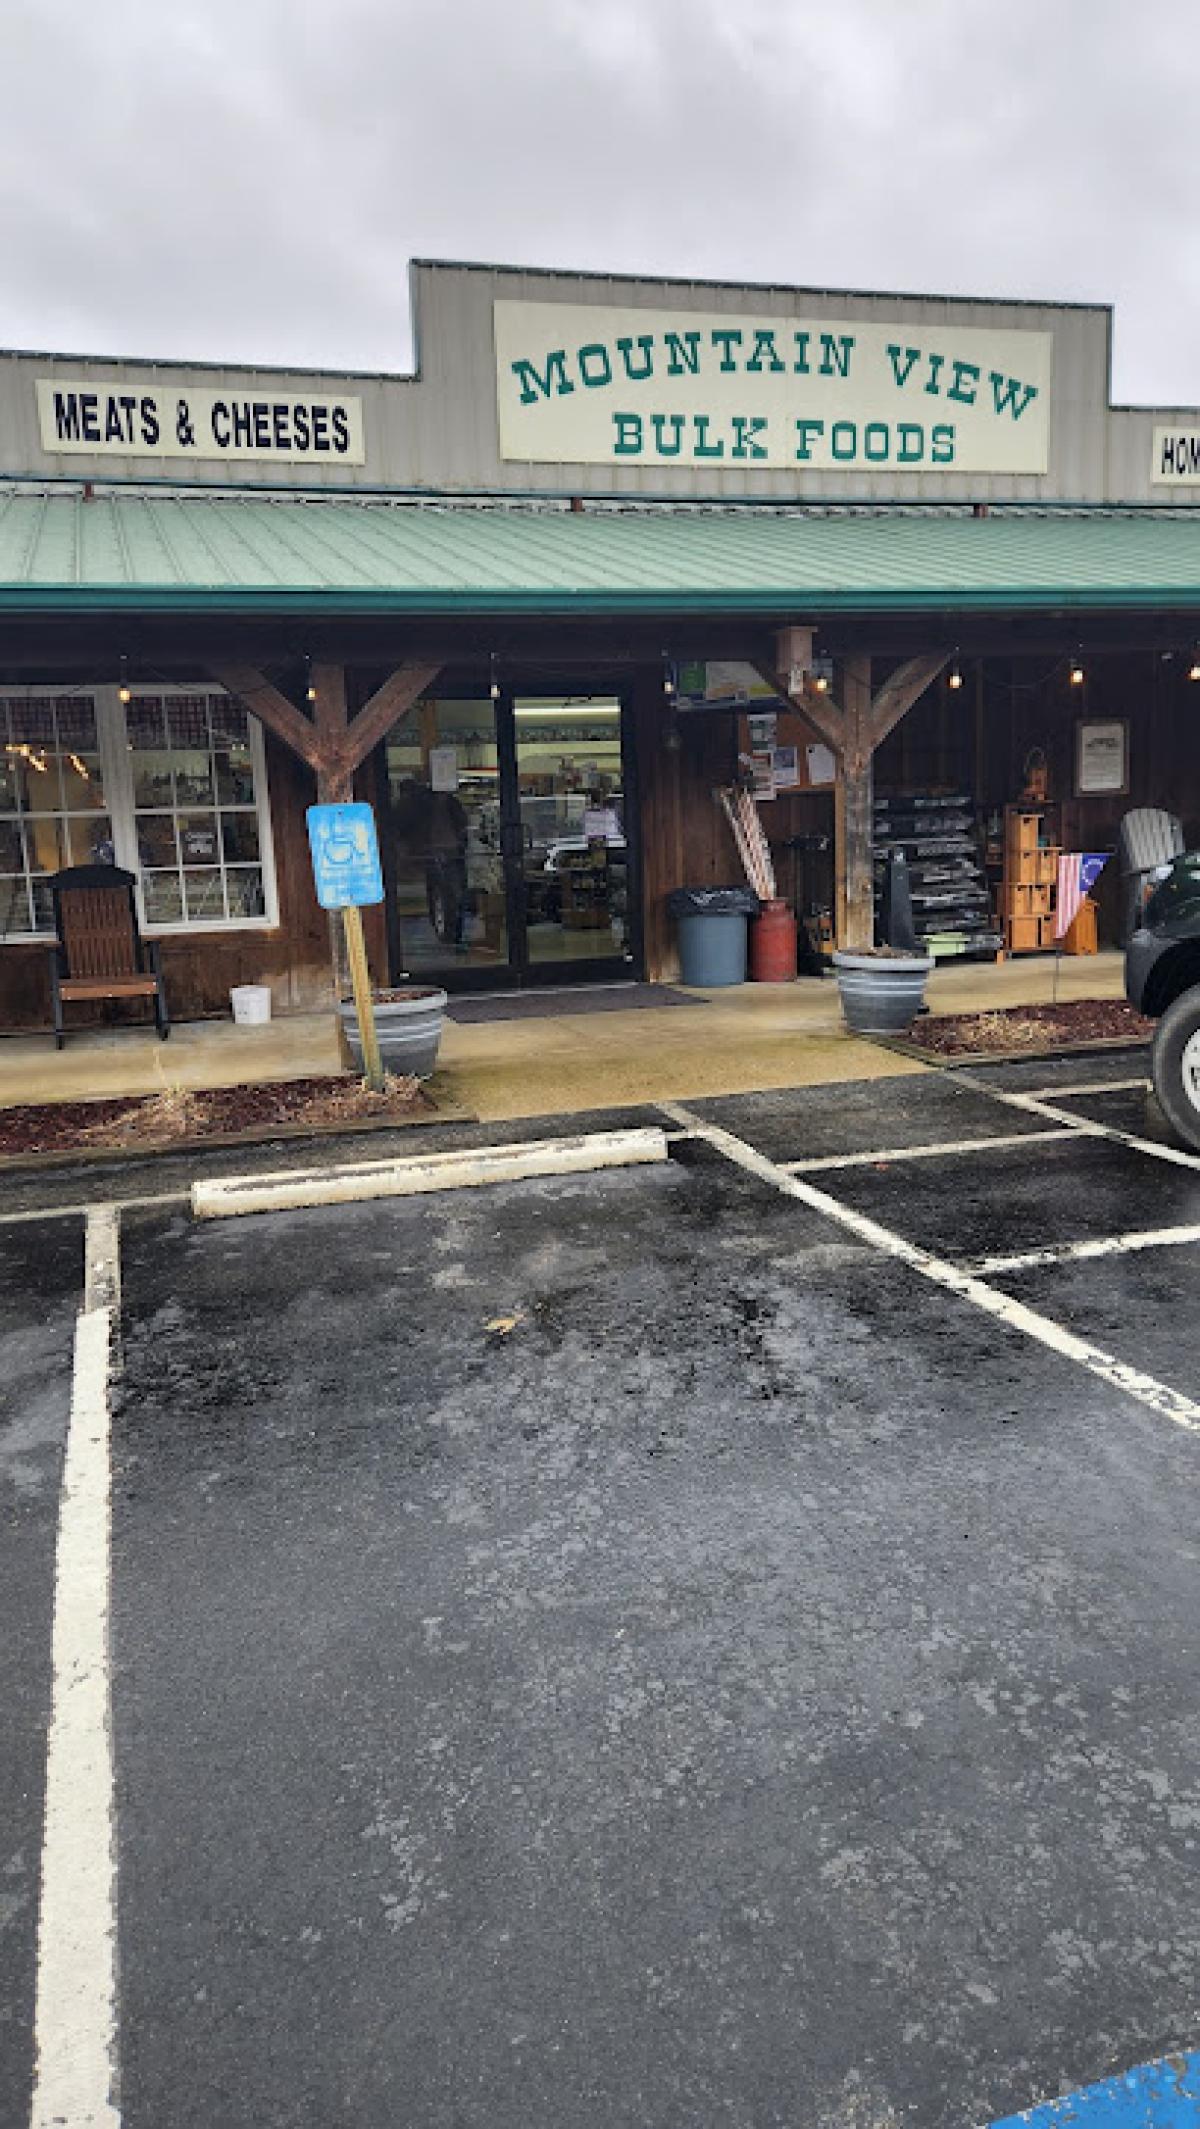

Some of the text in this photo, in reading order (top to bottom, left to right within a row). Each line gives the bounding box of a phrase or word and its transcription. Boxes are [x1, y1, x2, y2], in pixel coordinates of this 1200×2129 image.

[511, 329, 1039, 421] MOUNTAIN VIEW
[53, 392, 350, 453] MEATS & CHEESES
[612, 412, 956, 463] BULK FOODS
